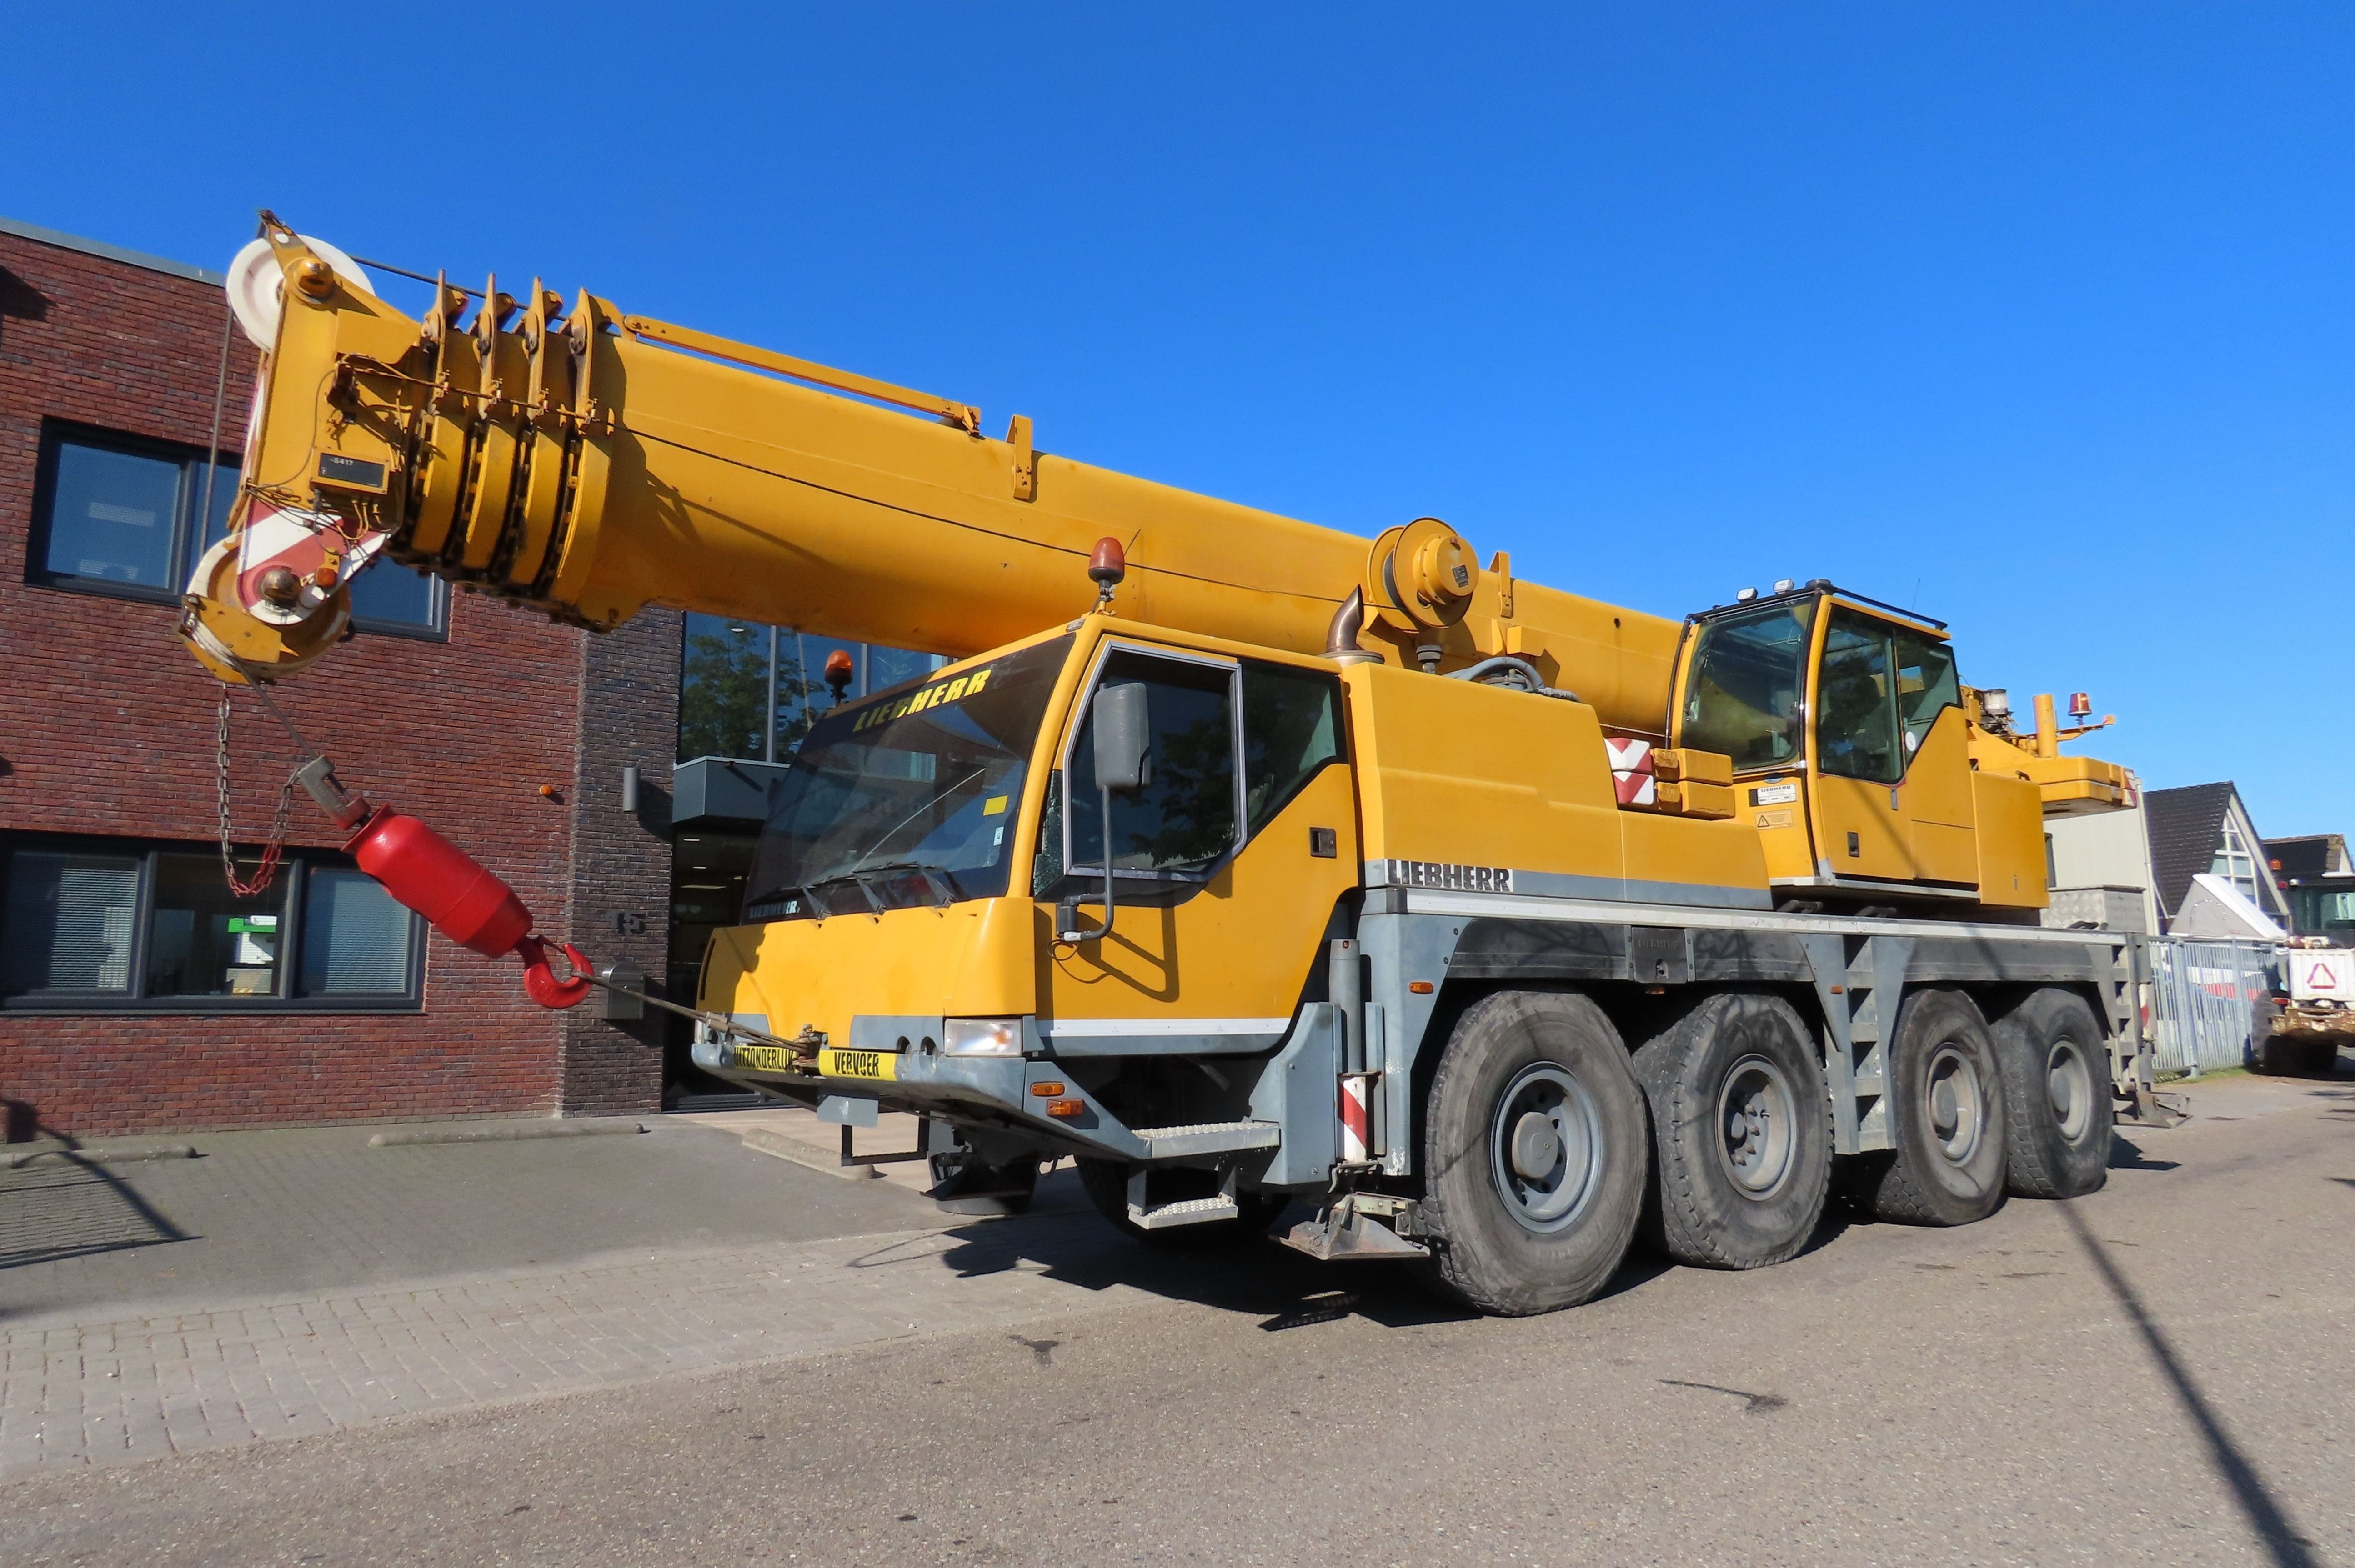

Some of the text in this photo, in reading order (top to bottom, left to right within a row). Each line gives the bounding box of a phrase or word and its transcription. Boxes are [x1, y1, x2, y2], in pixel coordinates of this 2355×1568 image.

[852, 669, 992, 733] LIEBHERR
[1388, 859, 1510, 893] LIEBHERR
[750, 900, 798, 918] LIEBHERR
[834, 1052, 879, 1077] VERVOER
